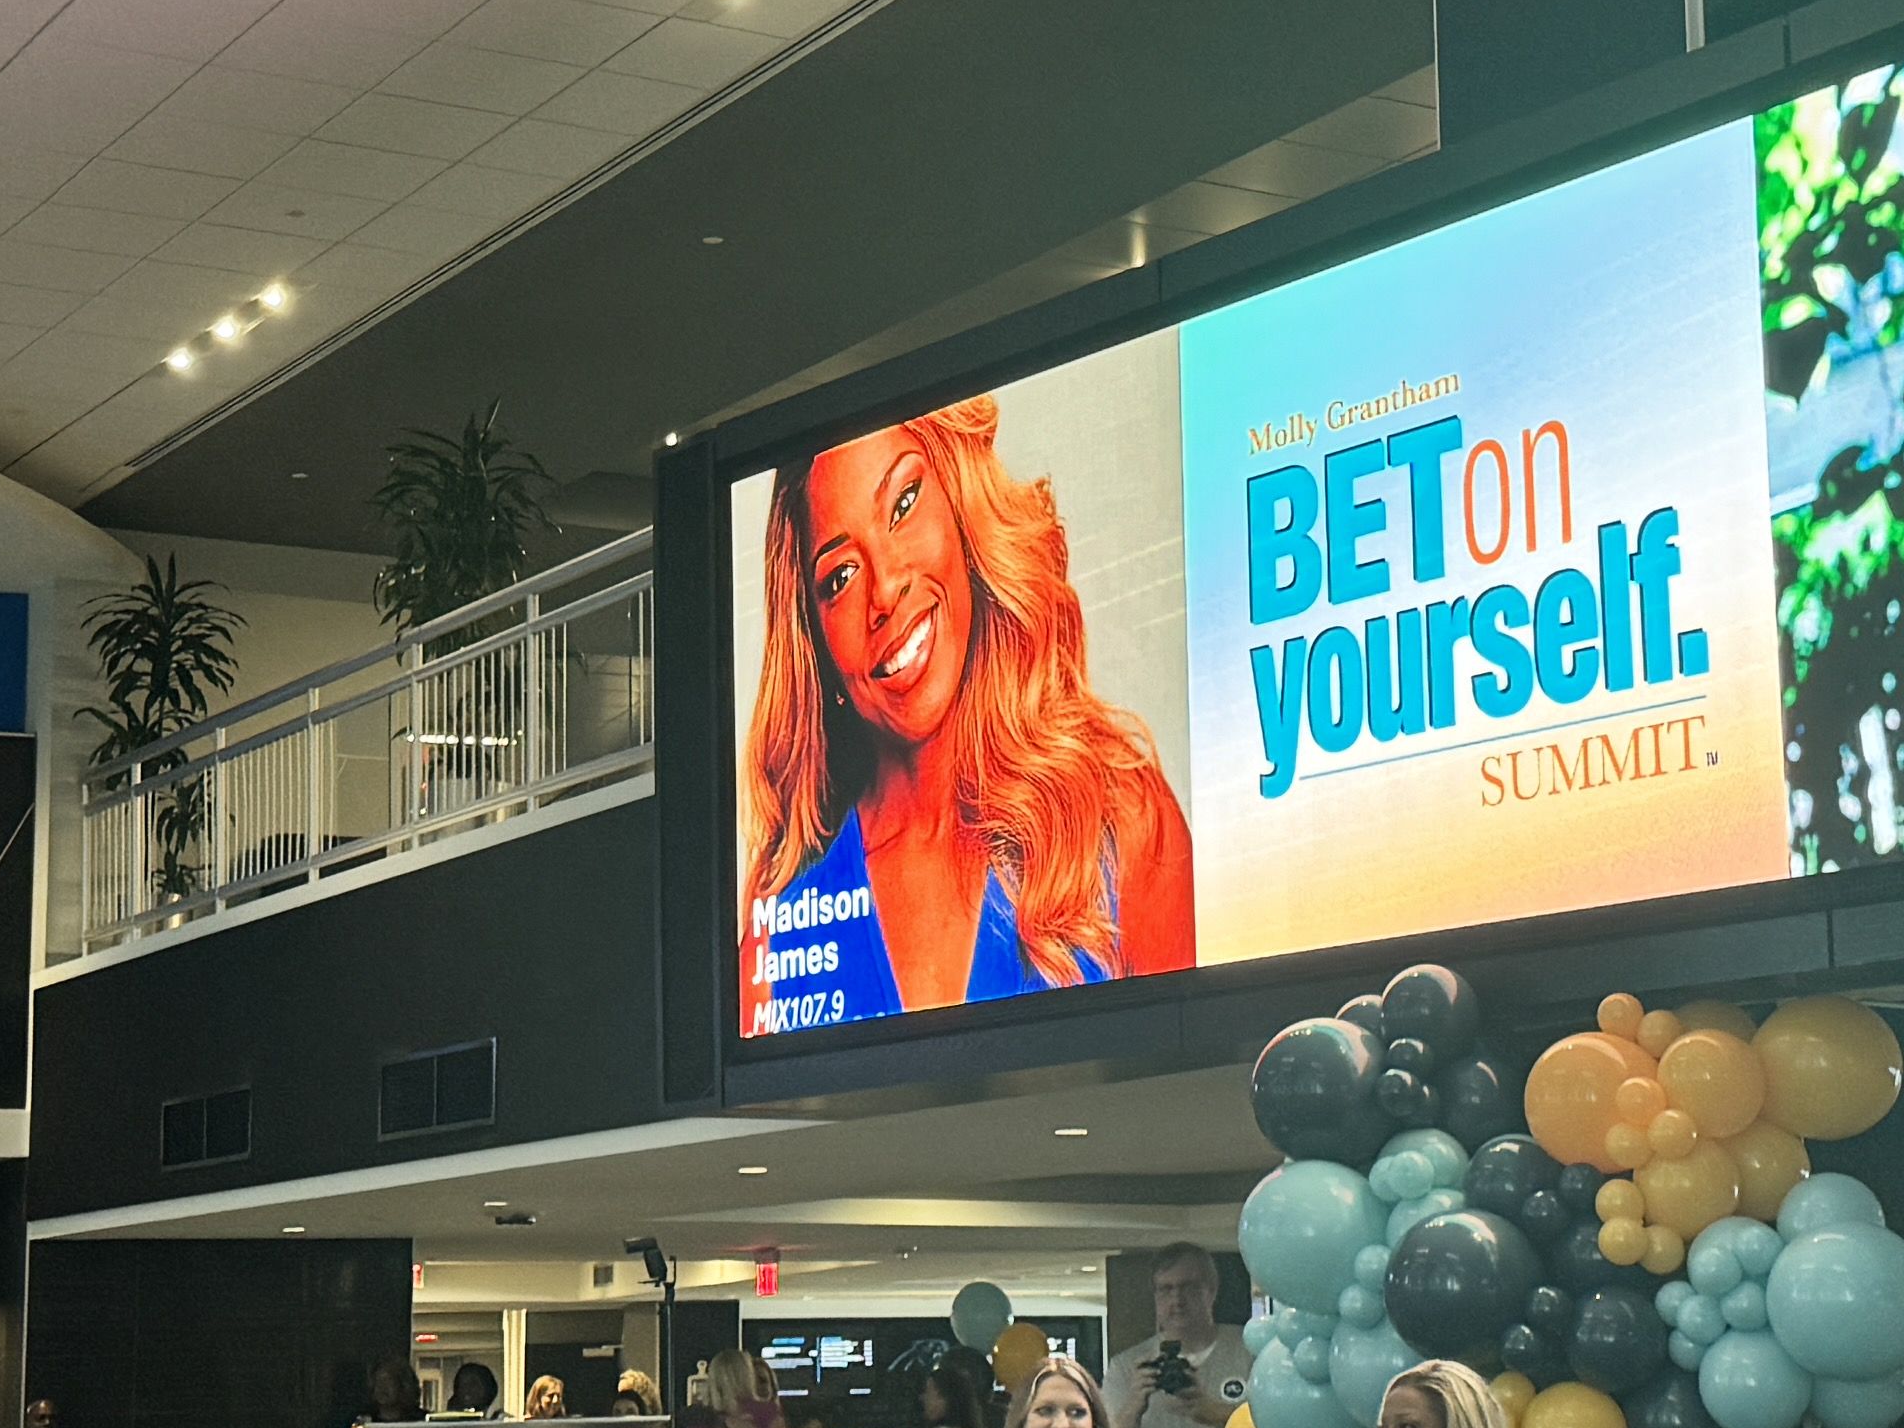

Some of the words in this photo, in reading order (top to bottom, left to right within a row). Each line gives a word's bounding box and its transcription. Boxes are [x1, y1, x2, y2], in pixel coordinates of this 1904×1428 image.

[1248, 413, 1318, 456] Molly
[1326, 372, 1460, 432] Grantham
[1246, 414, 1463, 625] BET
[1463, 420, 1572, 566] on
[1249, 506, 1710, 800] yourself.
[1479, 715, 1705, 808] SUMMIT
[752, 886, 870, 939] Madison
[752, 941, 839, 986] James
